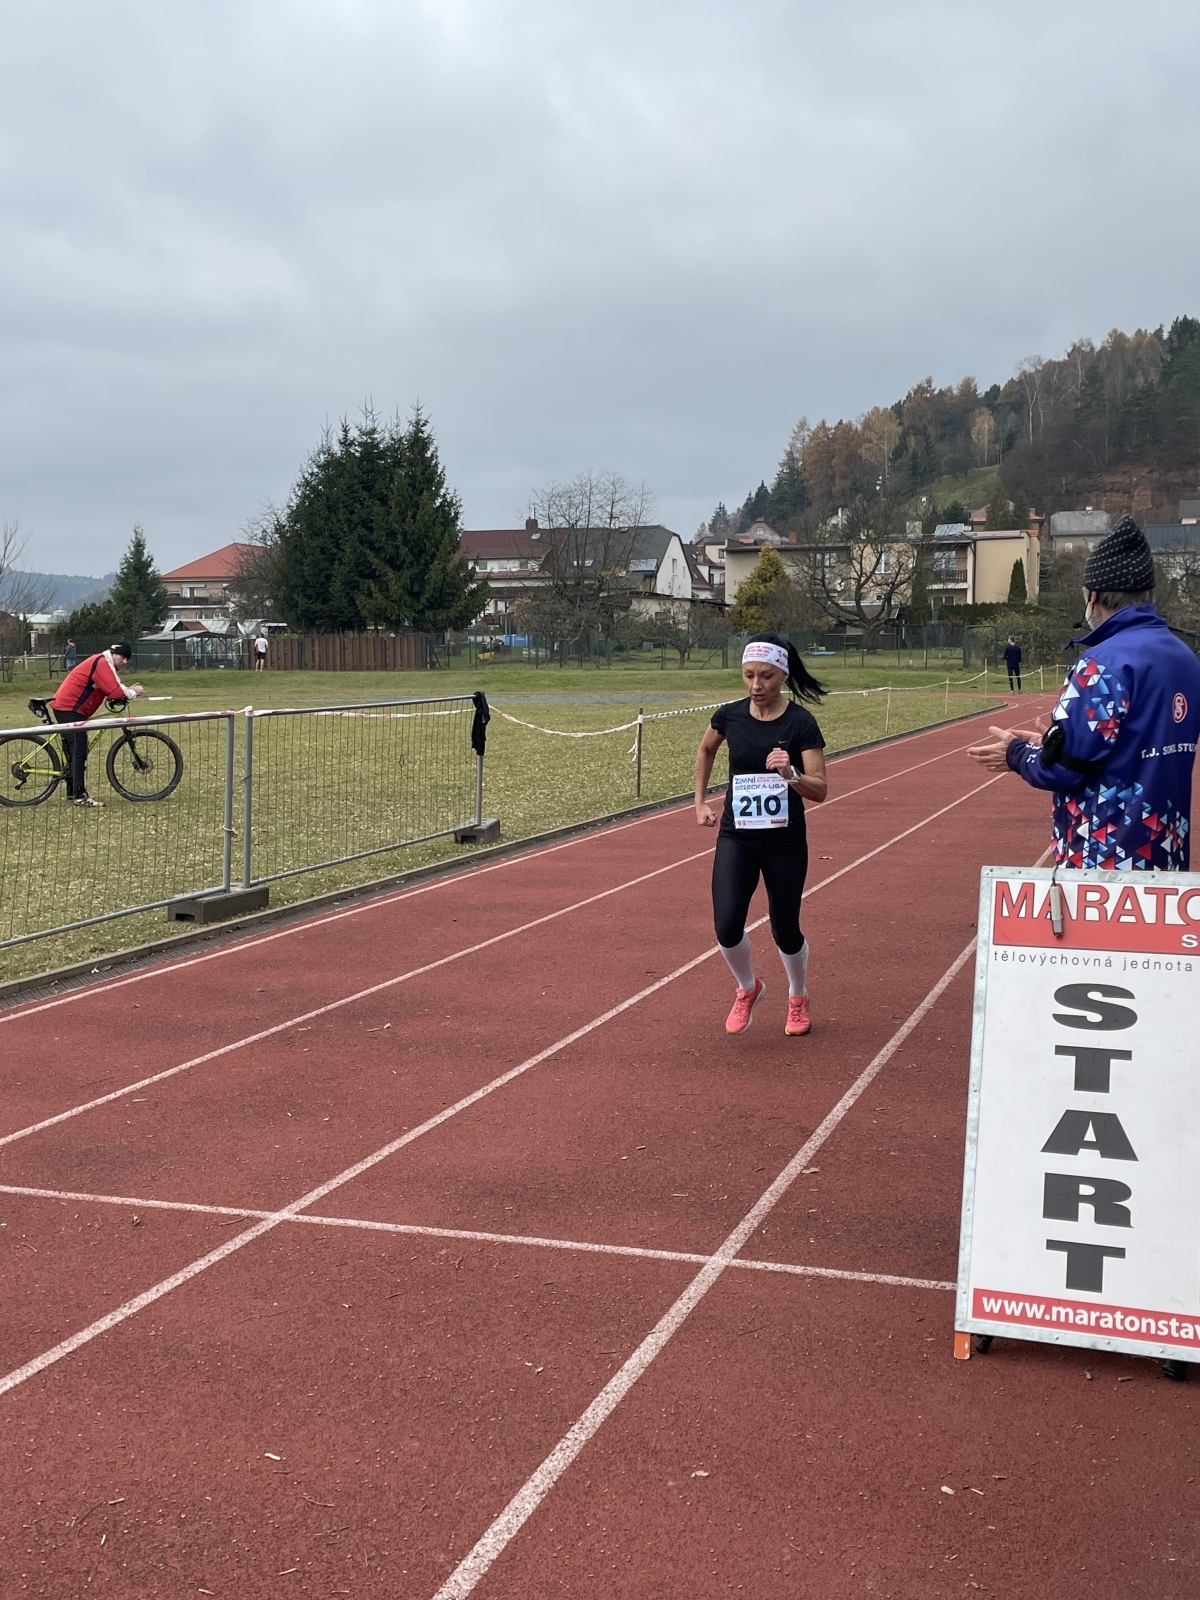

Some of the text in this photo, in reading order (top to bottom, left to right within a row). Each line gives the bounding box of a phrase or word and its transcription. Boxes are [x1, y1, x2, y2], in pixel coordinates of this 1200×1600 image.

[739, 794, 782, 817] 210
[993, 950, 1194, 972] tělovýchovná jednota
[1040, 982, 1139, 1294] START
